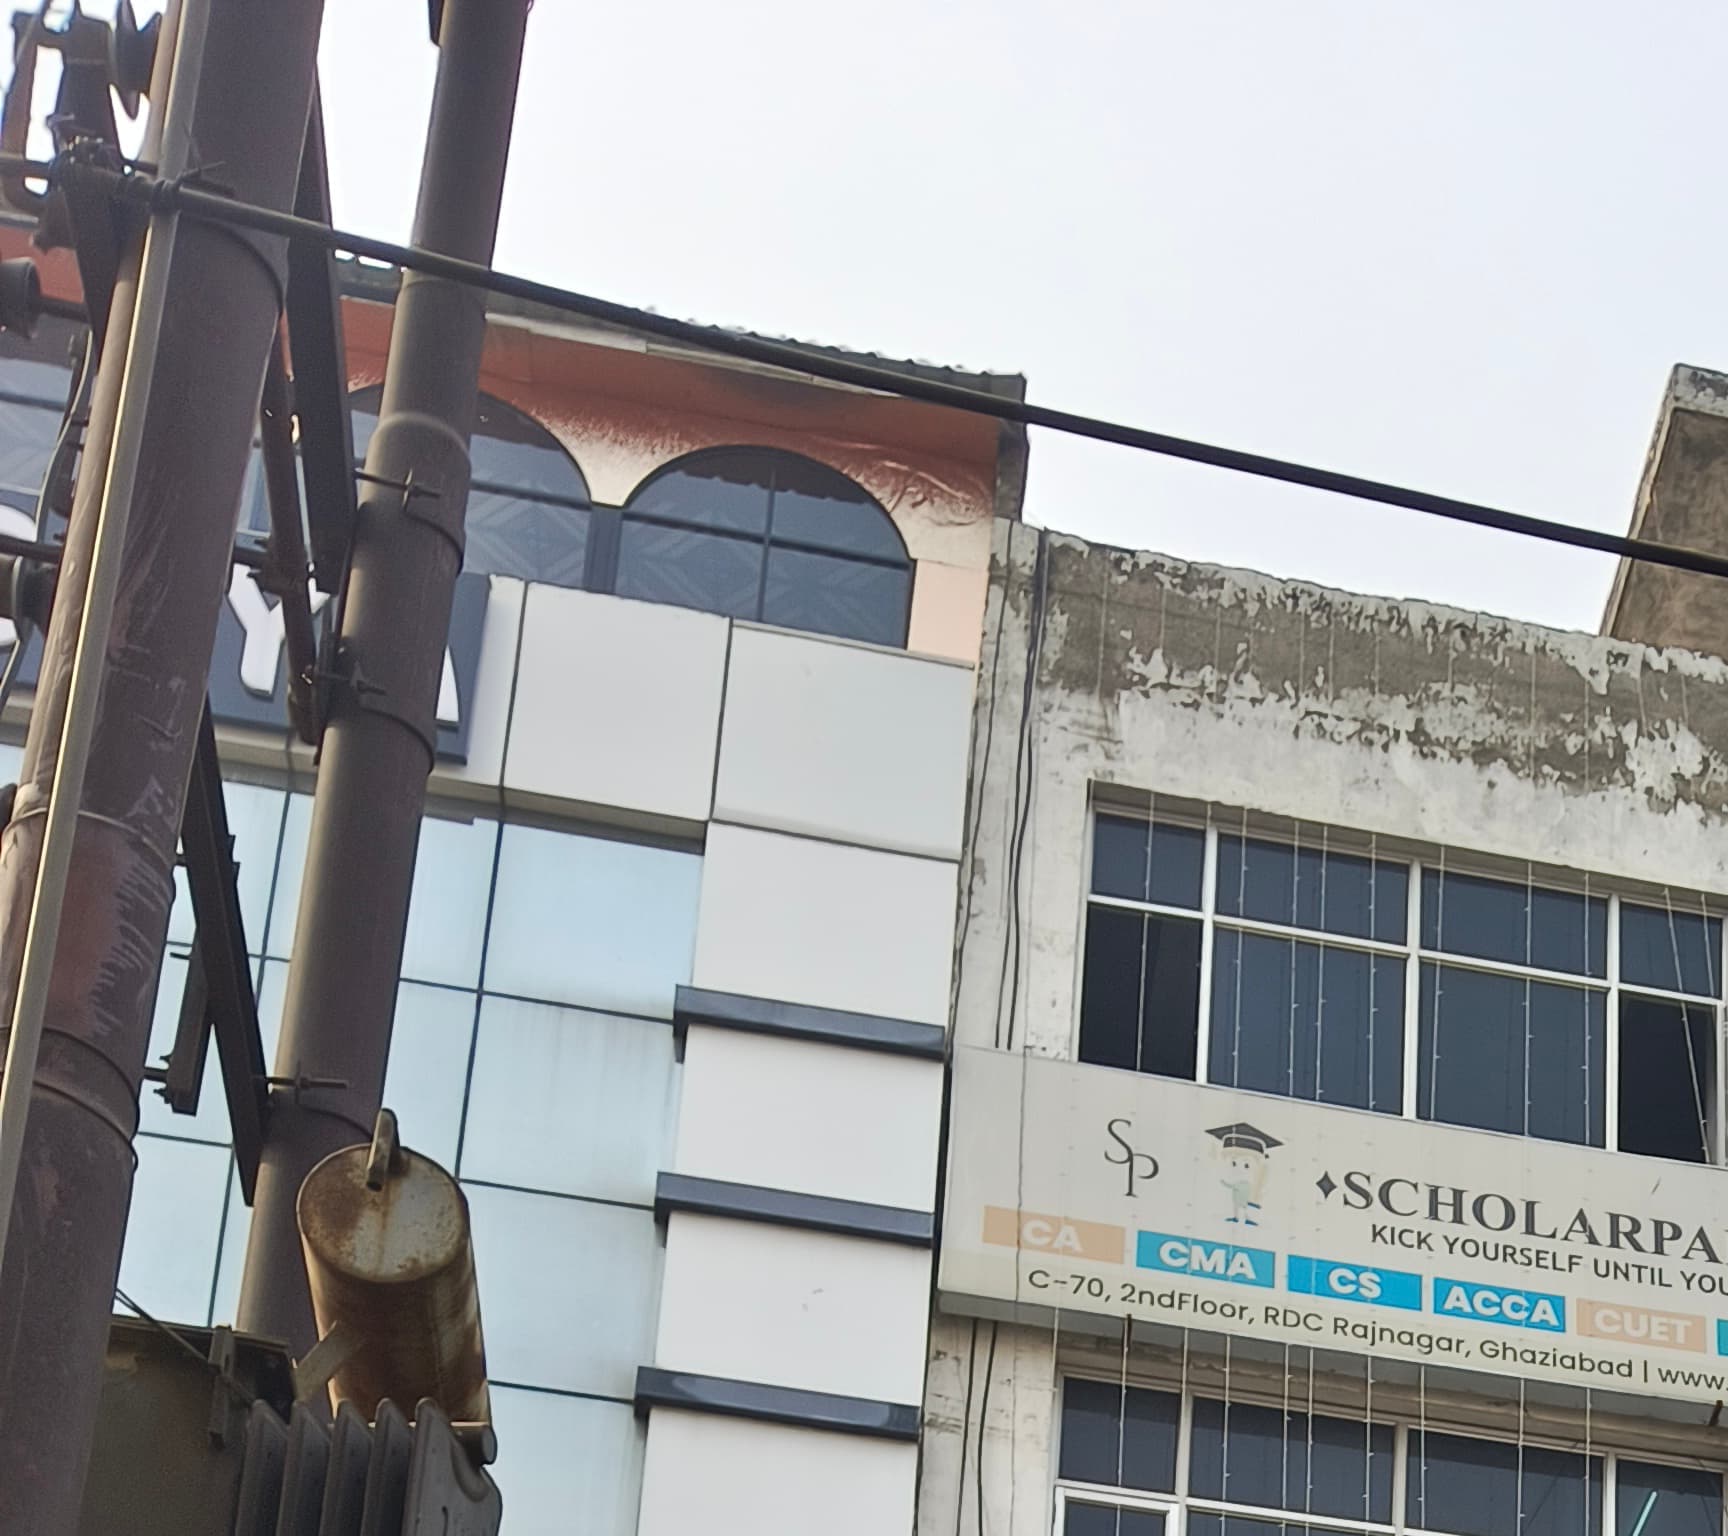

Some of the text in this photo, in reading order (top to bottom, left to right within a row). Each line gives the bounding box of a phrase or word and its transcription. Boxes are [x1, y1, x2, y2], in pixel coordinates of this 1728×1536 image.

[1021, 1218, 1083, 1254] CA
[1370, 1223, 1434, 1253] KICK
[1442, 1235, 1584, 1275] YOURSELF
[1593, 1256, 1673, 1289] UNTIL
[1159, 1240, 1259, 1281] CMA
[1328, 1267, 1383, 1300] CS
[1027, 1268, 1112, 1303] C-70,
[1264, 1305, 1323, 1332] RDC
[1332, 1317, 1472, 1358] Rajnagar,
[1479, 1338, 1633, 1379] Ghaziabad
[1442, 1286, 1561, 1327] ACCA
[1593, 1307, 1693, 1345] CUET
